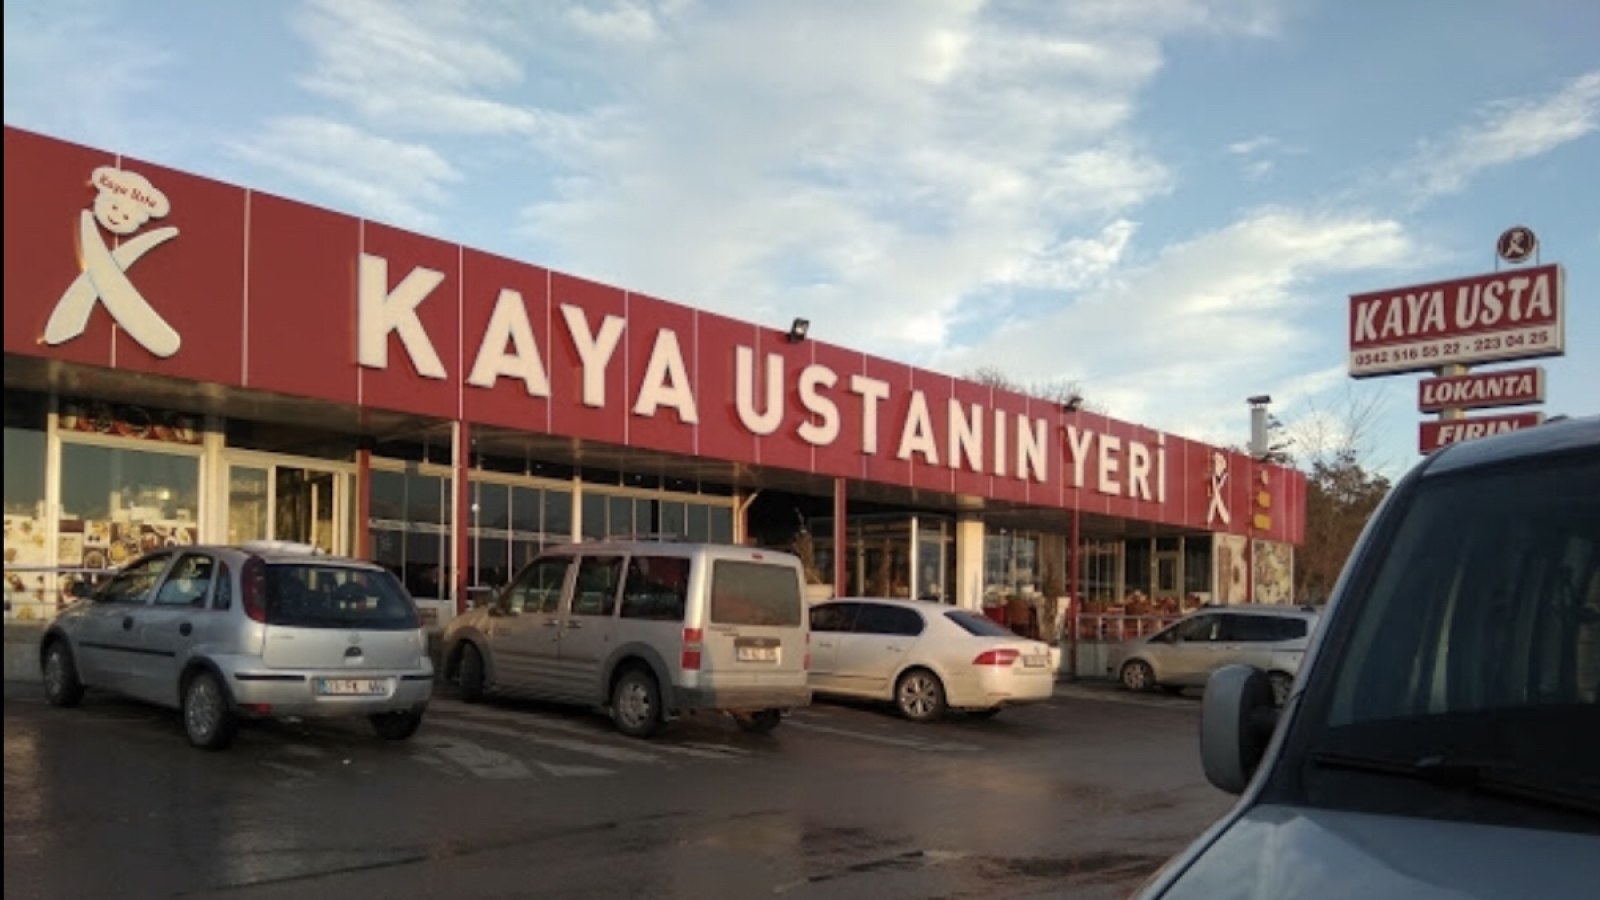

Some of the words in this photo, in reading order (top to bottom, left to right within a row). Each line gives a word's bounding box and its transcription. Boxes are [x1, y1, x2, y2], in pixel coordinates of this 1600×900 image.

[1355, 290, 1447, 343] KAYA
[1455, 273, 1552, 329] USTA
[1355, 352, 1389, 367] 0542
[1392, 347, 1418, 363] 516
[1443, 341, 1460, 356] 22
[1474, 337, 1501, 352] 223
[1506, 333, 1525, 348] 04
[357, 252, 699, 425] KAYA
[735, 344, 1049, 483] USTANIN
[1064, 430, 1167, 504] YERİ
[1423, 374, 1533, 404] LOKANTA
